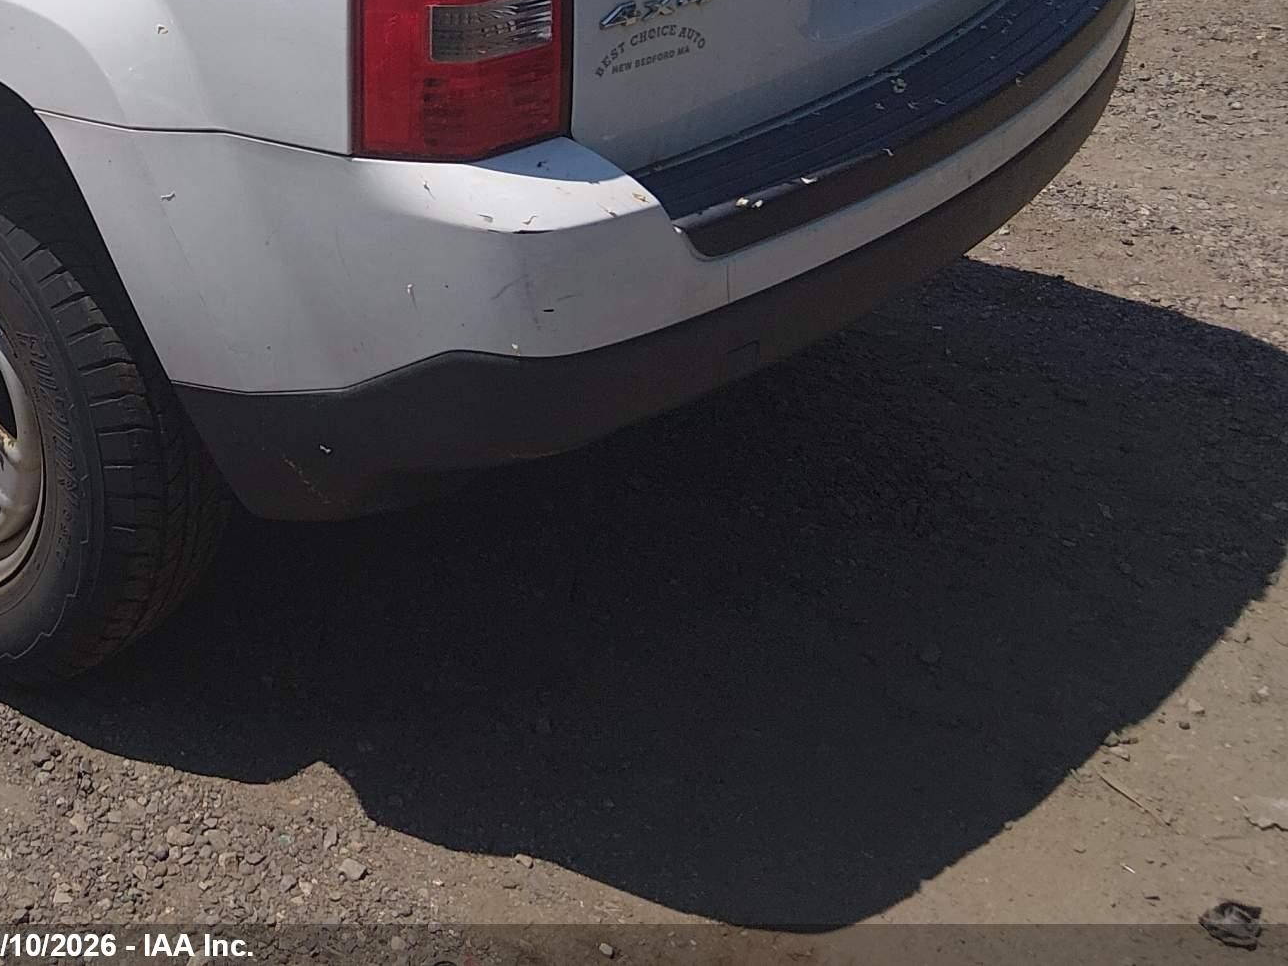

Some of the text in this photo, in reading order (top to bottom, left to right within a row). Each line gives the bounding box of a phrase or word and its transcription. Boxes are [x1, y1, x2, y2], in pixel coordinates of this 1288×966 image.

[595, 25, 706, 78] BEST CHOICE AUTO
[611, 45, 691, 75] NEW BEDFORD MA
